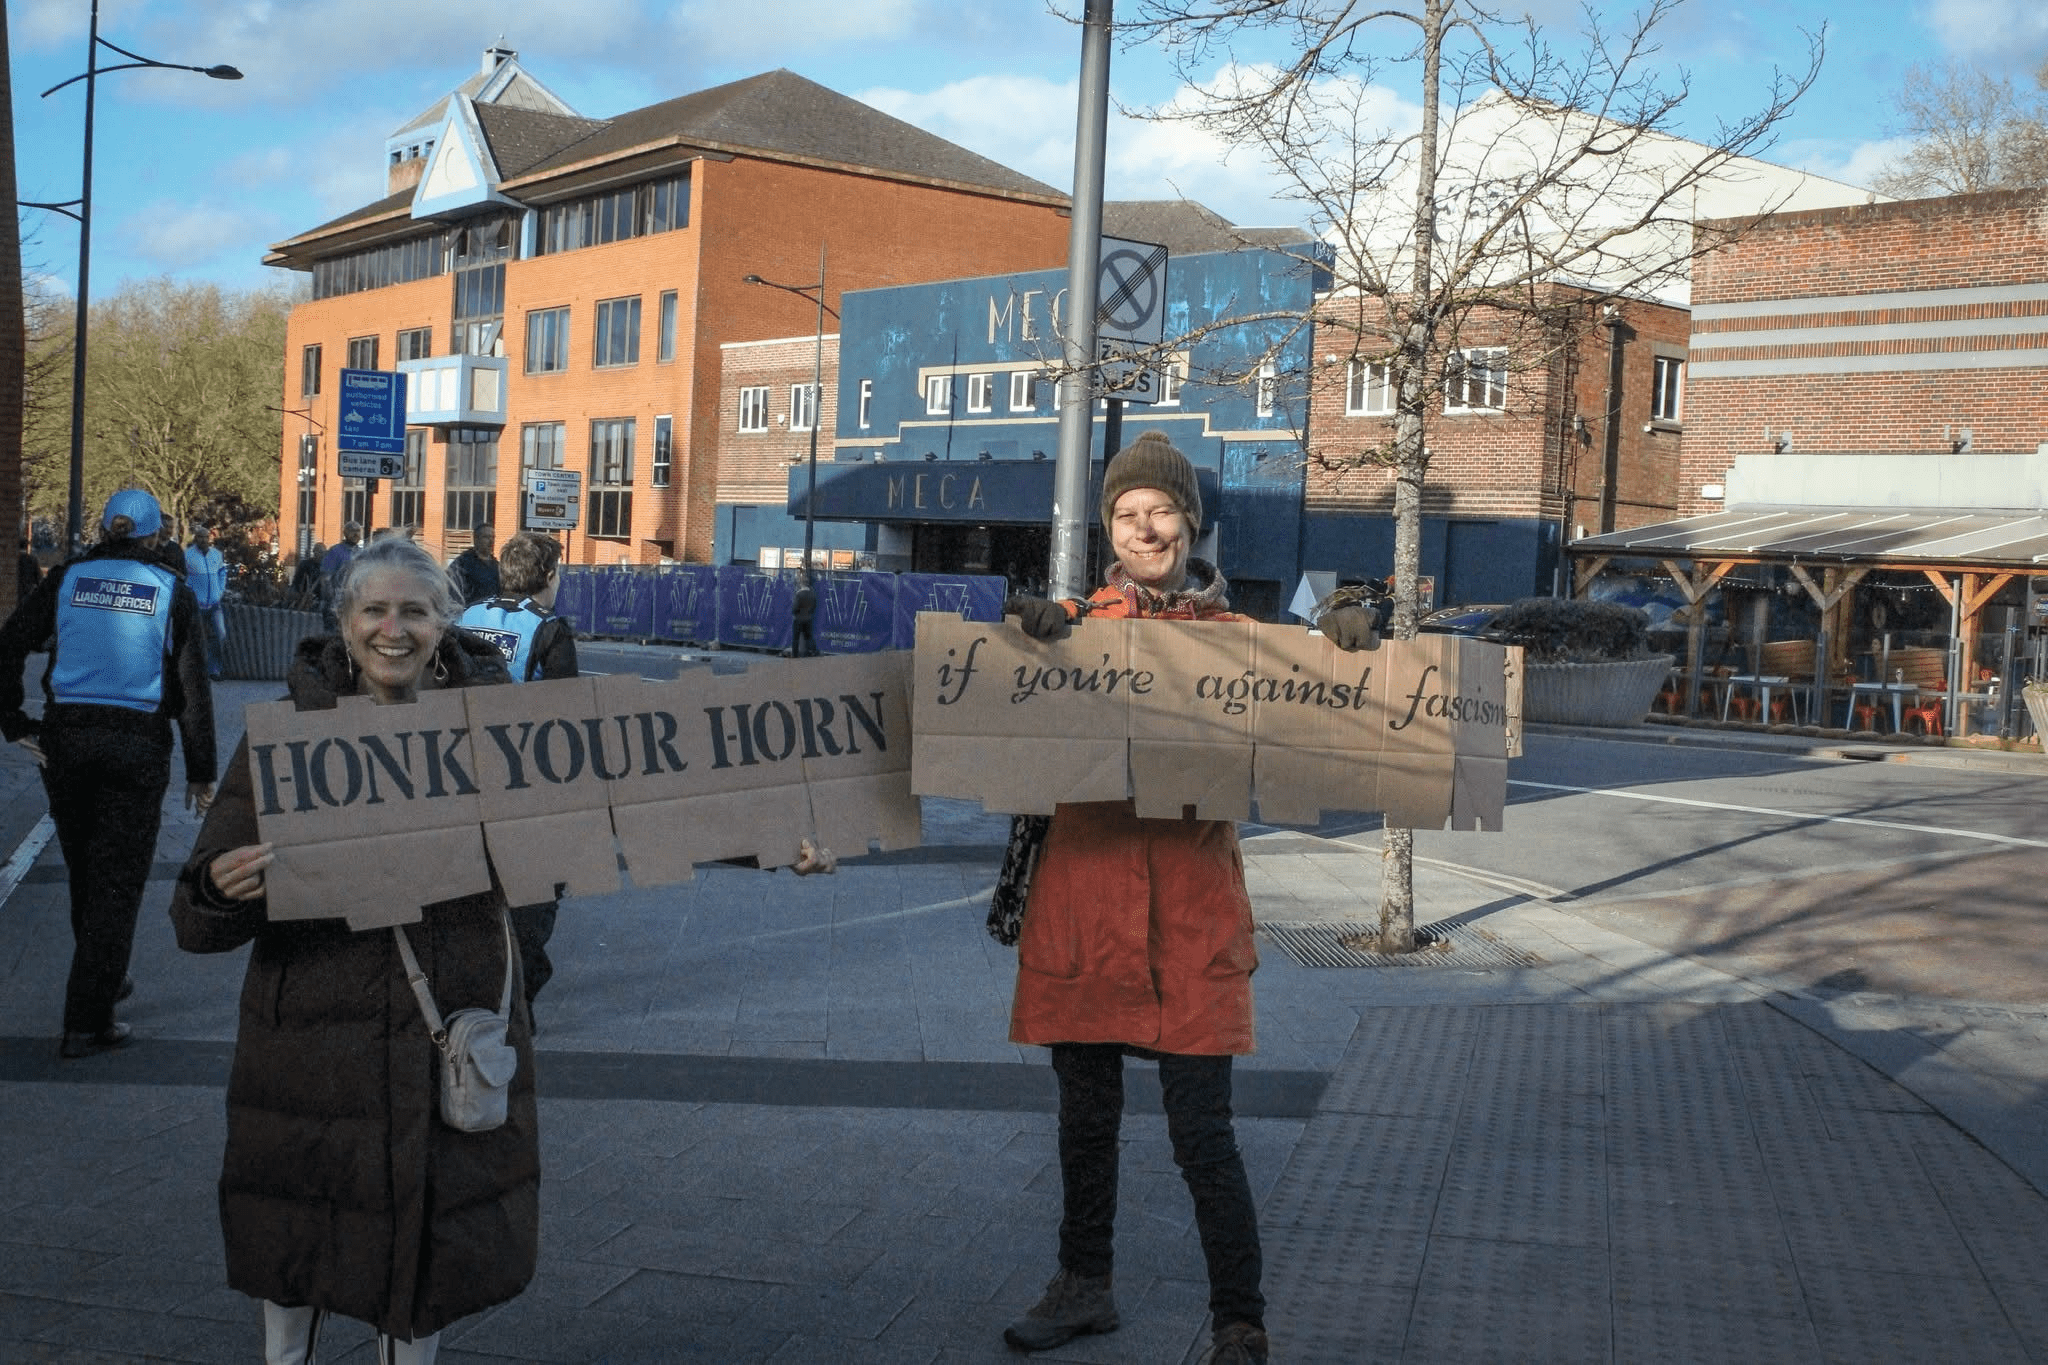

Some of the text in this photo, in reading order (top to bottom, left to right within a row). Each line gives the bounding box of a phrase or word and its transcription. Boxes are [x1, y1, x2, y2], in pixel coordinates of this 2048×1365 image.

[343, 456, 360, 464] Bus
[888, 474, 984, 510] MECA
[75, 591, 152, 610] LIAISON OFFICER
[100, 581, 132, 595] POLICE
[936, 636, 1505, 731] if you're against fascism
[252, 691, 887, 816] HONK YOUR HORN
